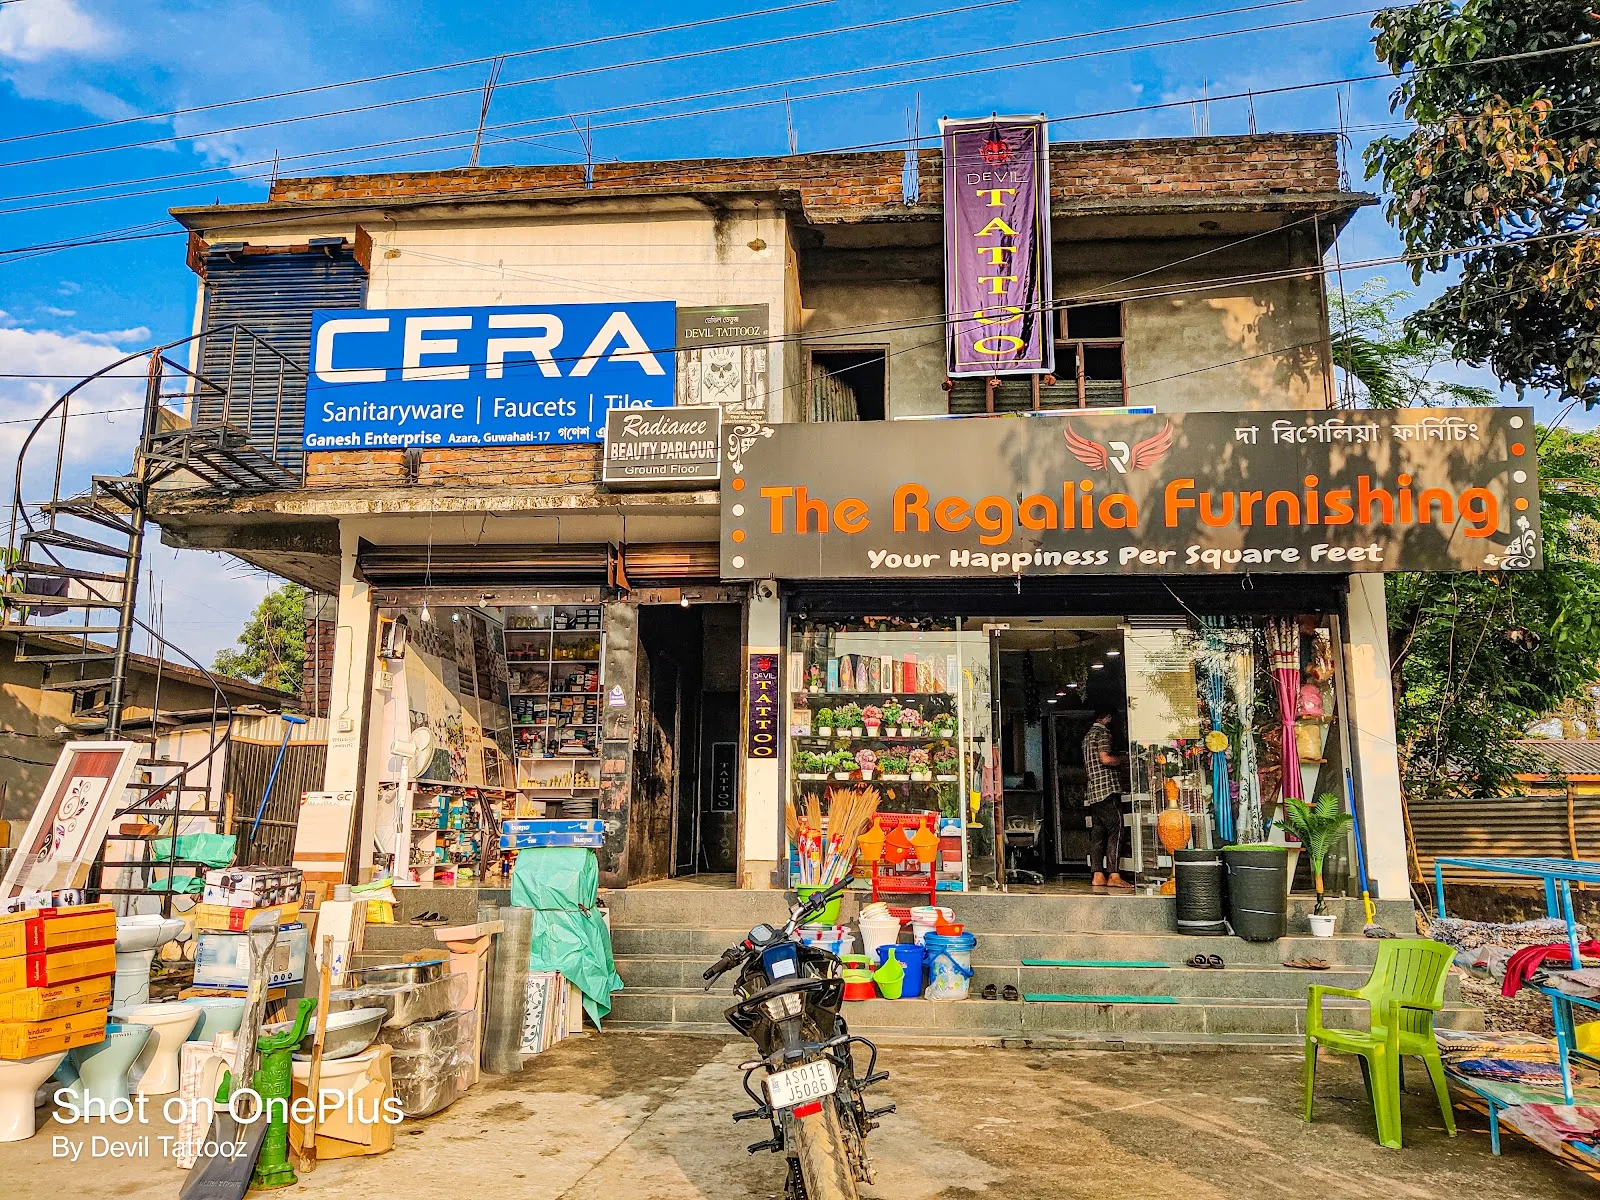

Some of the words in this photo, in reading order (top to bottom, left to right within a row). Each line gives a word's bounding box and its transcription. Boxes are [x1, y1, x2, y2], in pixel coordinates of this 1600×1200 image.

[967, 171, 1028, 185] DEVIL
[973, 188, 1026, 355] TATTOO
[685, 328, 713, 339] DEVIL
[716, 326, 760, 337] TATTOOZ
[315, 311, 666, 383] CERA
[322, 401, 464, 427] Sanitaryware
[494, 396, 576, 419] Faucets
[621, 414, 707, 438] Radiance
[306, 432, 366, 446] Ganesh
[368, 430, 441, 448] Enterprise
[448, 432, 481, 444] Azara,
[483, 431, 550, 443] Guwahati-17
[610, 442, 657, 461] BEAUTY
[660, 440, 715, 460] PARLOUR
[624, 465, 667, 475] Ground
[670, 464, 700, 474] Floor
[760, 484, 870, 535] The
[892, 479, 1139, 546] Regalia
[1164, 473, 1500, 539] Furnishing
[867, 549, 941, 569] Your
[949, 548, 1109, 574] Happiness
[1119, 547, 1177, 566] Per
[1185, 546, 1301, 570] Square
[1311, 543, 1384, 563] Feet
[753, 672, 776, 680] DEVIL
[753, 681, 773, 756] TATTOO
[718, 762, 729, 807] TATTOO
[789, 1082, 828, 1102] J5086
